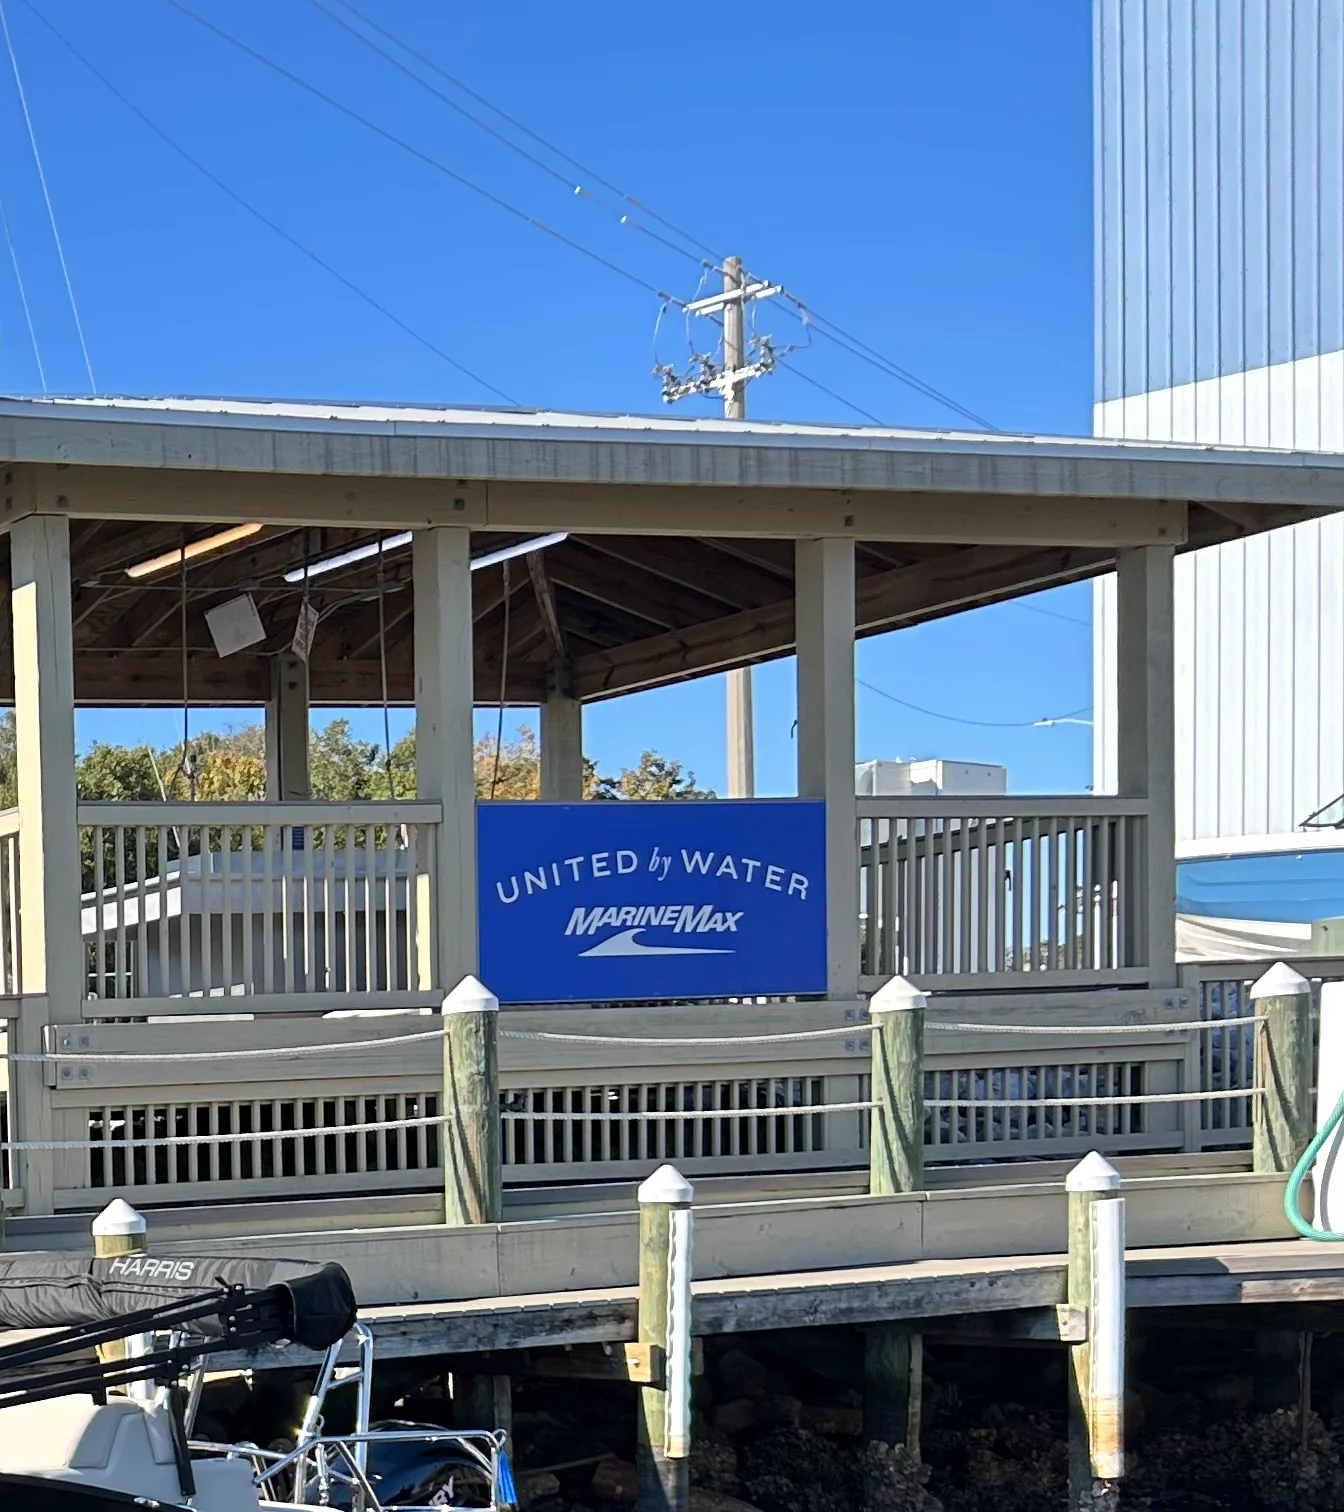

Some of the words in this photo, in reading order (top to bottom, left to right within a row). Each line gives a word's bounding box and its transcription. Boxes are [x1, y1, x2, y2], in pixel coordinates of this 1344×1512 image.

[496, 848, 639, 904] UNITED
[648, 846, 672, 883] by
[680, 848, 810, 900] WATER
[108, 1257, 195, 1281] HARRIS
